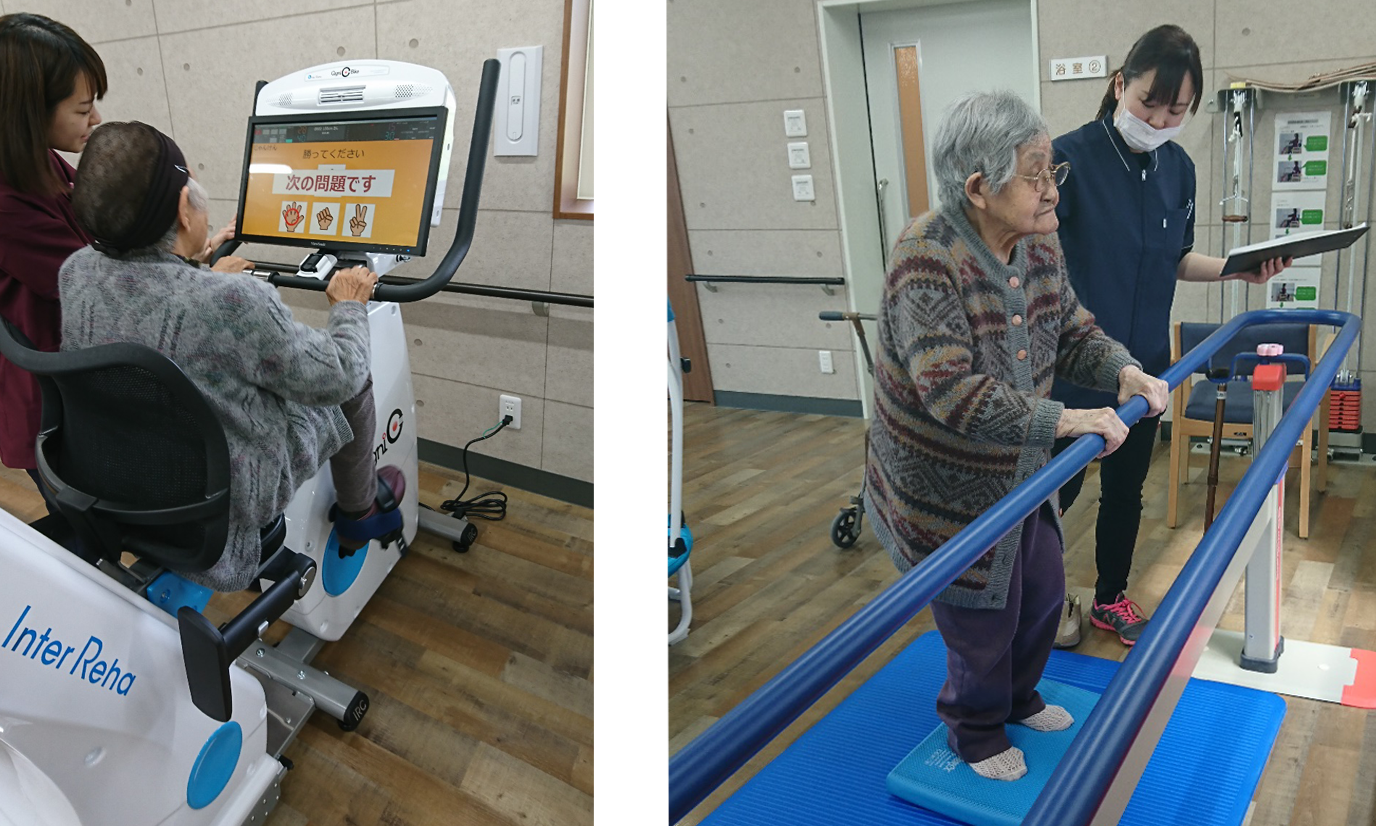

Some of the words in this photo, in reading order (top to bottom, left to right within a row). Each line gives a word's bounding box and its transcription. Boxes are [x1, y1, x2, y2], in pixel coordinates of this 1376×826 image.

[303, 149, 365, 159] 勝ってください
[285, 174, 377, 193] 次の問題です
[1, 605, 75, 670] Inter
[69, 635, 137, 696] Reha
[352, 699, 367, 721] IRC
